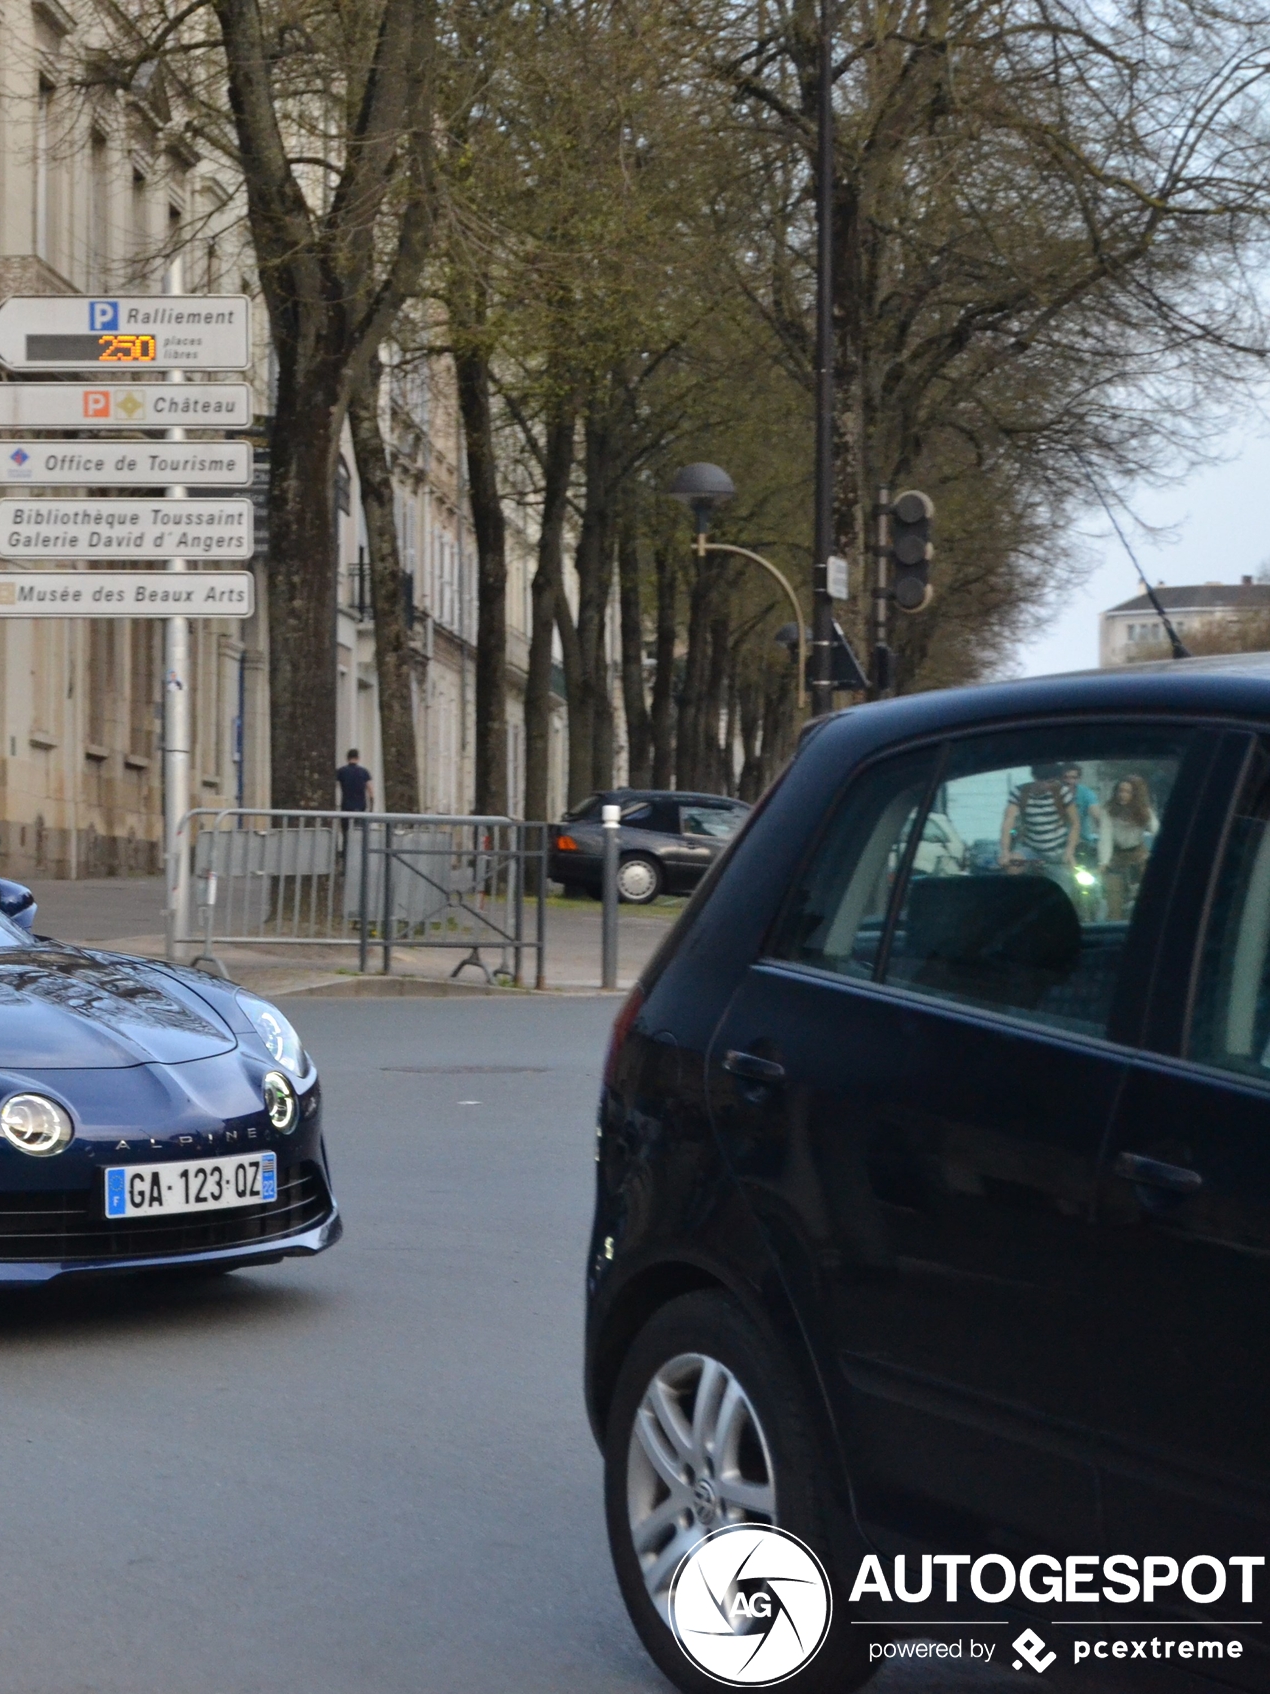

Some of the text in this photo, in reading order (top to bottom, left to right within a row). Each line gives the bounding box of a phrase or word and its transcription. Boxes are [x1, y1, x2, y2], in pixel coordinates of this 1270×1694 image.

[127, 308, 235, 324] Ralliement
[99, 335, 156, 361] 250
[163, 336, 203, 347] places
[163, 349, 198, 359] libres
[154, 396, 236, 413] Château
[45, 455, 236, 471] Office de Tourisme
[13, 509, 139, 529] Bibliothèque
[151, 509, 243, 525] Toussaint
[8, 532, 79, 548] Galerie
[88, 532, 144, 548] David
[16, 586, 245, 602] Musée des Beaux Arts
[116, 1127, 257, 1150] ALPINE
[263, 1180, 274, 1196] 22
